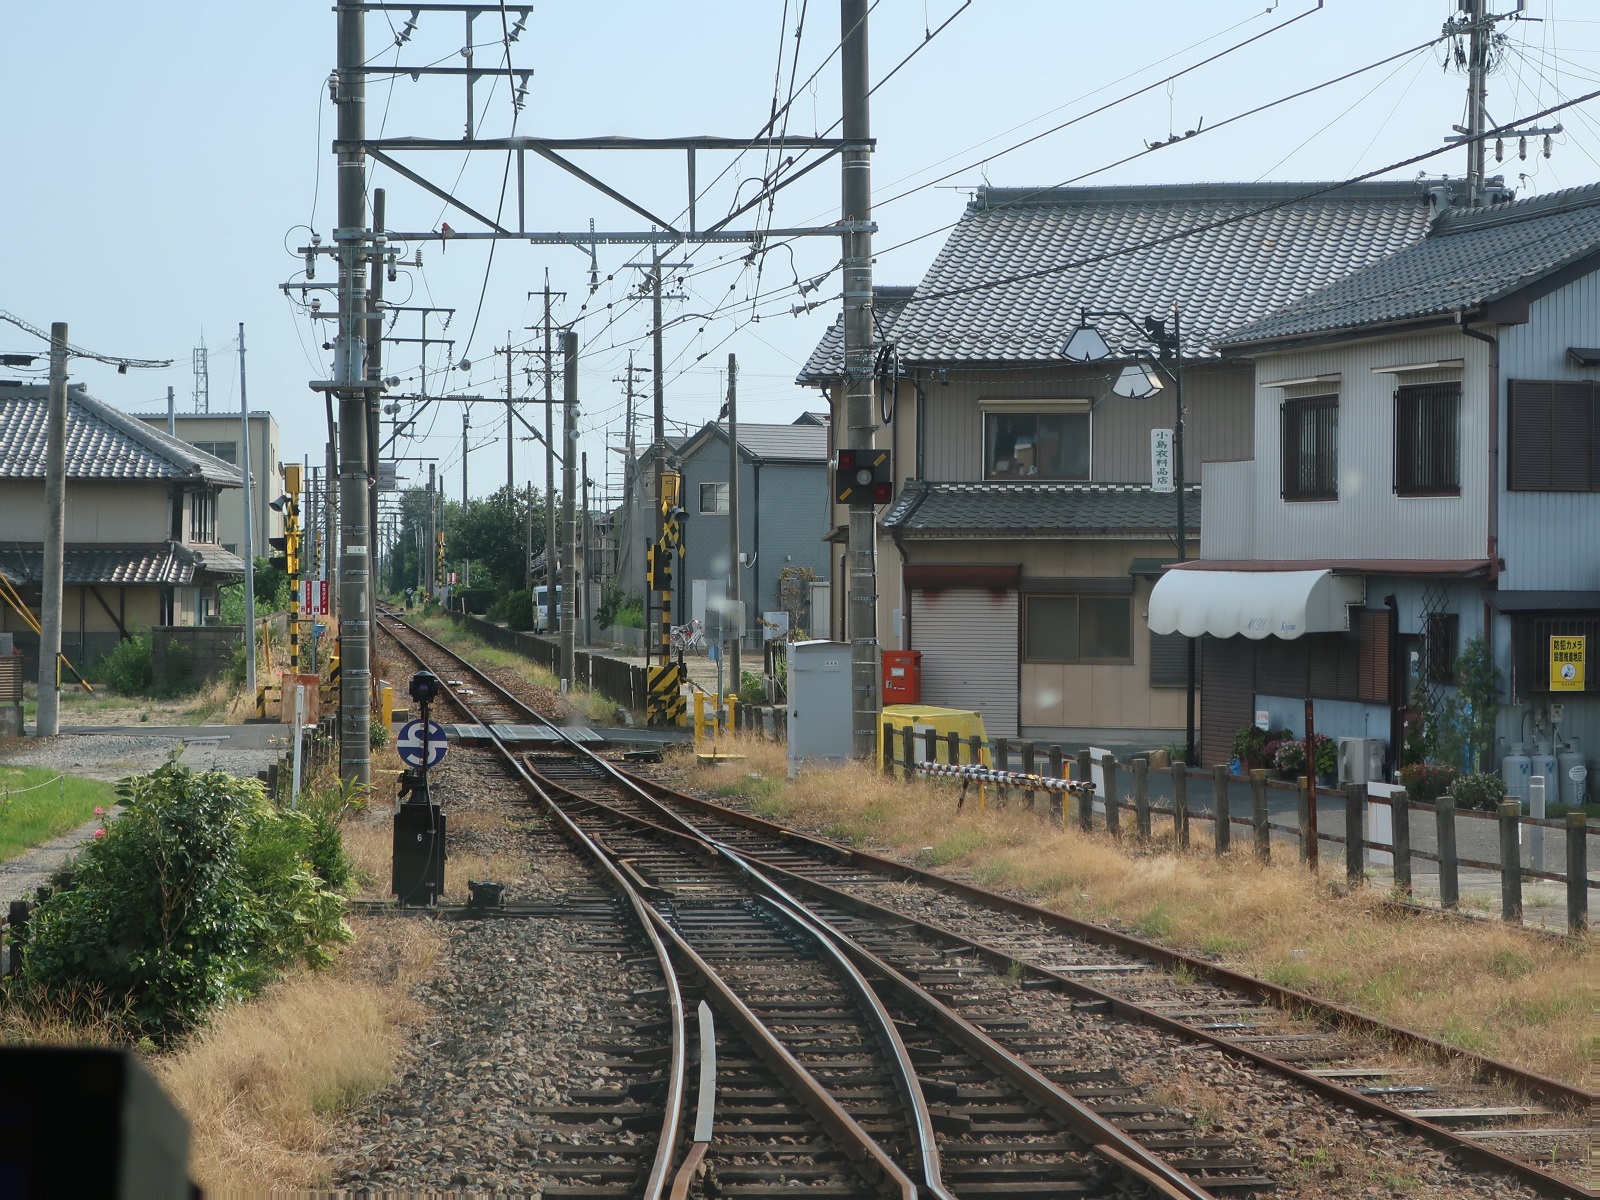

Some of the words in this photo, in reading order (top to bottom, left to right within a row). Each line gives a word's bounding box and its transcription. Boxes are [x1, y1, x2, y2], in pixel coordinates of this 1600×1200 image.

[1156, 432, 1168, 484] 小島衣料品店
[1554, 640, 1582, 650] 防犯カメラ
